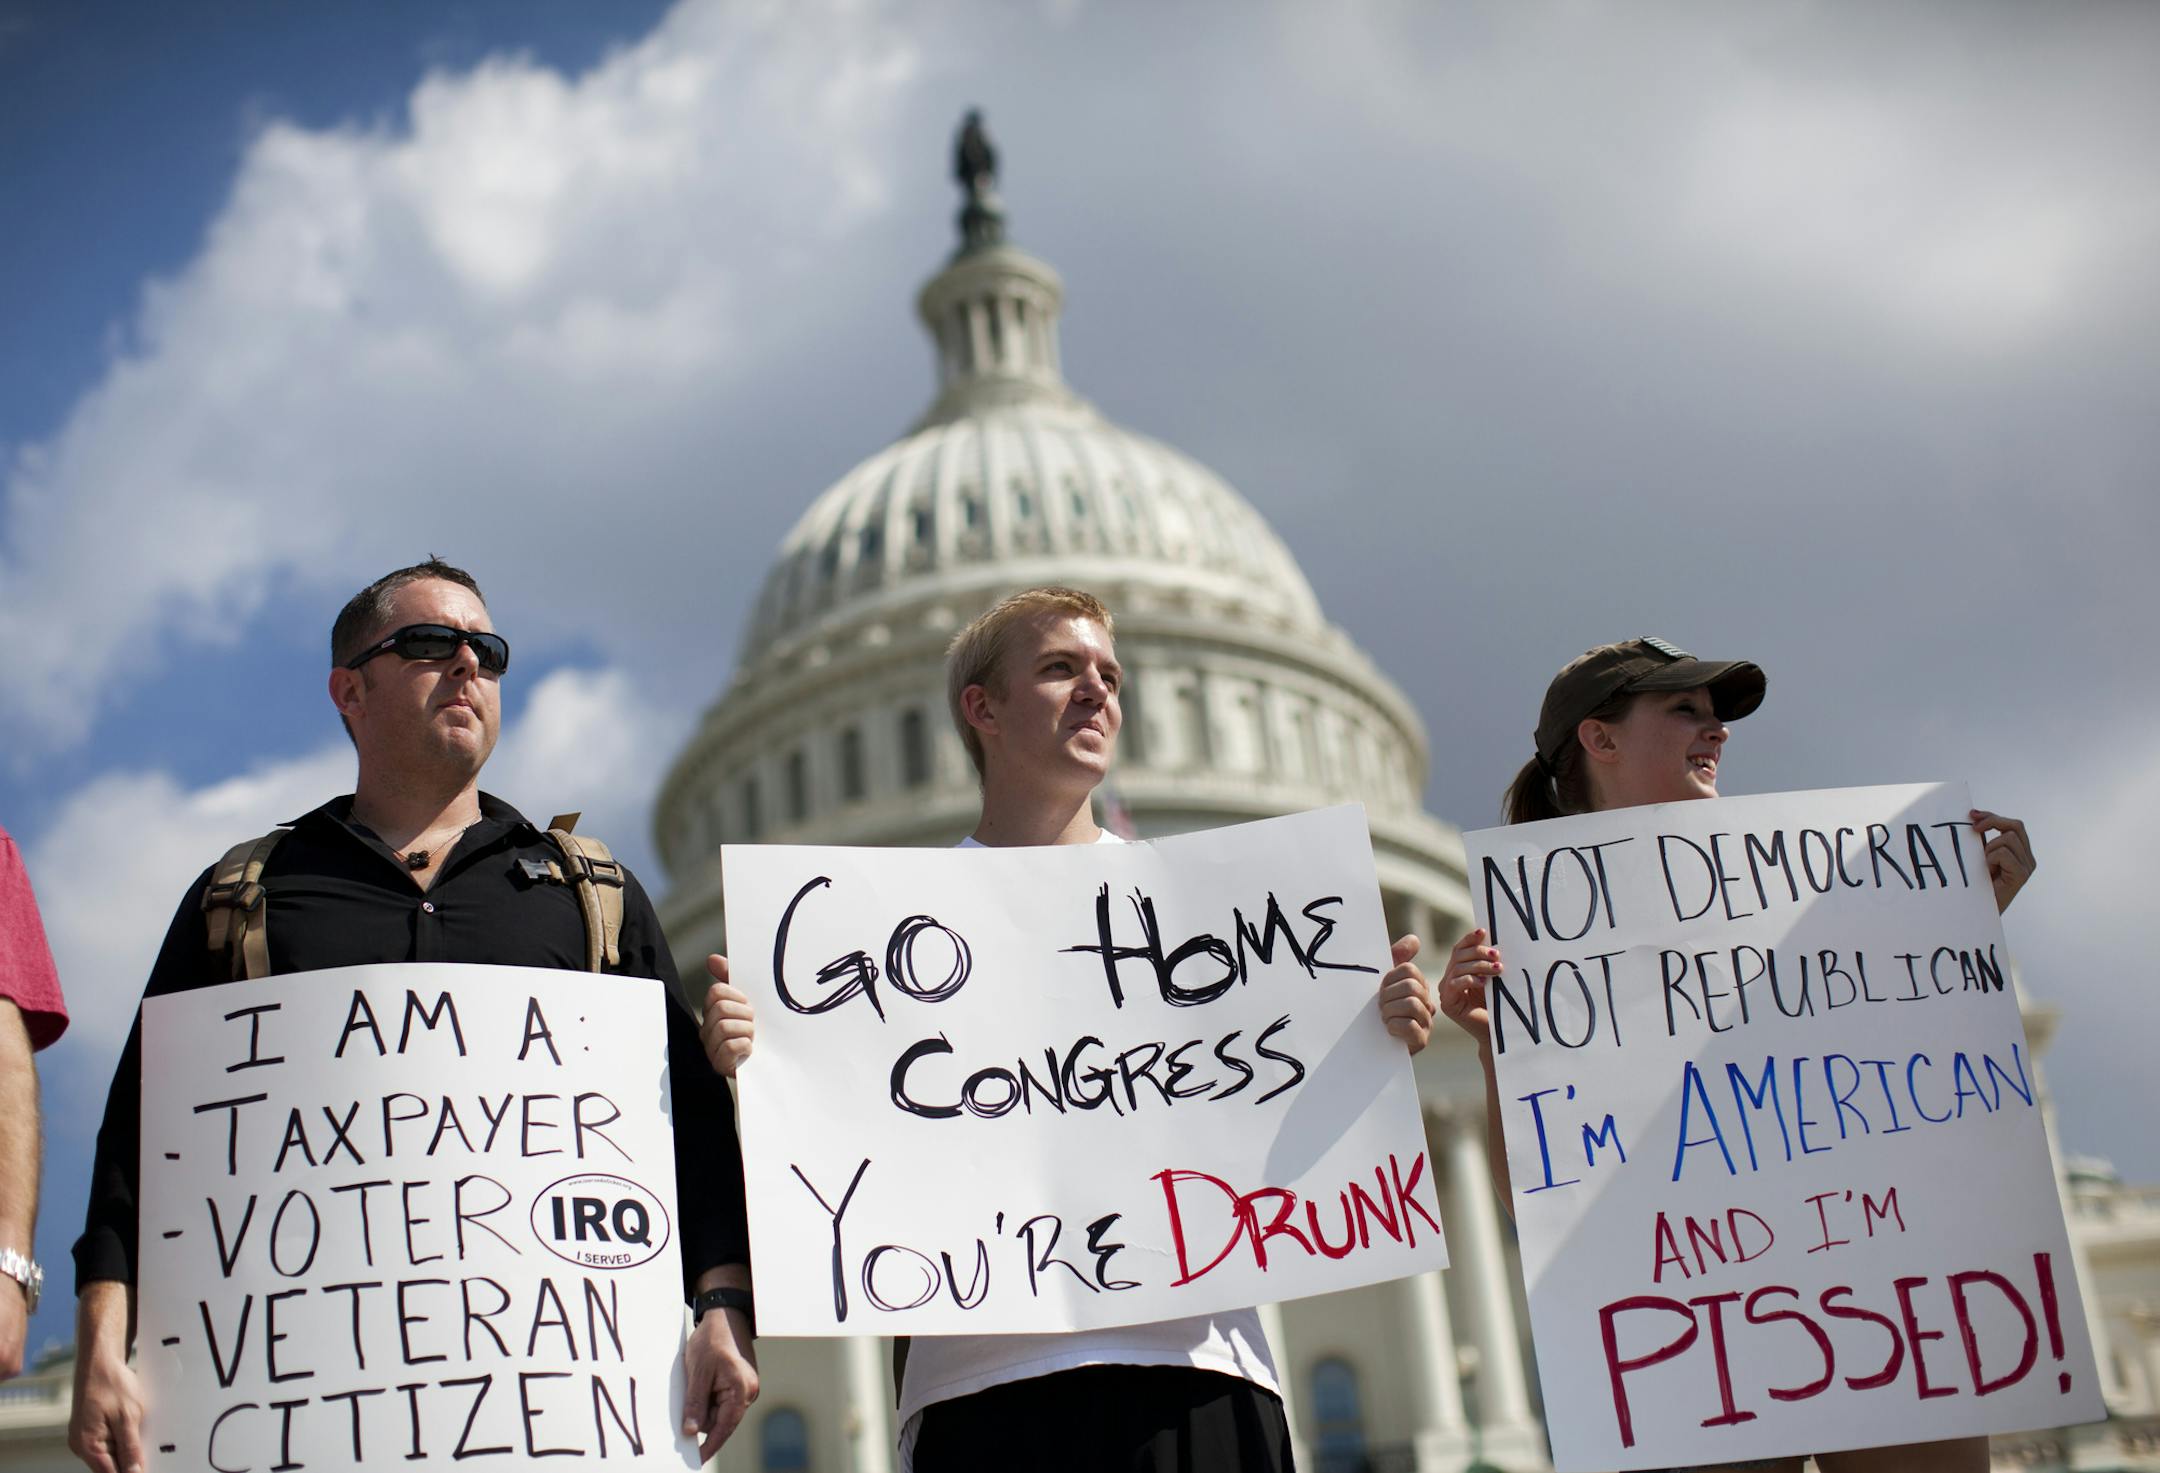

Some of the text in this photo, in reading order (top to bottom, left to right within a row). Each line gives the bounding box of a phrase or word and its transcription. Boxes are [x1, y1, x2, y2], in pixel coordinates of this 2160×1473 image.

[1481, 820, 1975, 946] NOT DEMOCRAT
[771, 874, 1381, 1023] GO HOME
[1491, 942, 2005, 1055] NOT REPUBLICAN
[223, 1002, 286, 1074] I
[334, 988, 468, 1059] AM
[889, 1013, 1306, 1120] CONGRESS
[192, 1091, 635, 1177] TAXPAYER
[1671, 1042, 2035, 1182] AMERICAN
[205, 1174, 523, 1279] VOTER
[551, 1196, 653, 1249] IRQ
[584, 1251, 632, 1266] SERVED
[789, 1150, 1442, 1323] YOU'RE DRUNK
[1651, 1185, 1907, 1284] AND I'M
[198, 1277, 626, 1390] VETERAN
[1598, 1251, 2073, 1448] PISSED!
[208, 1372, 645, 1473] CITIZEN
